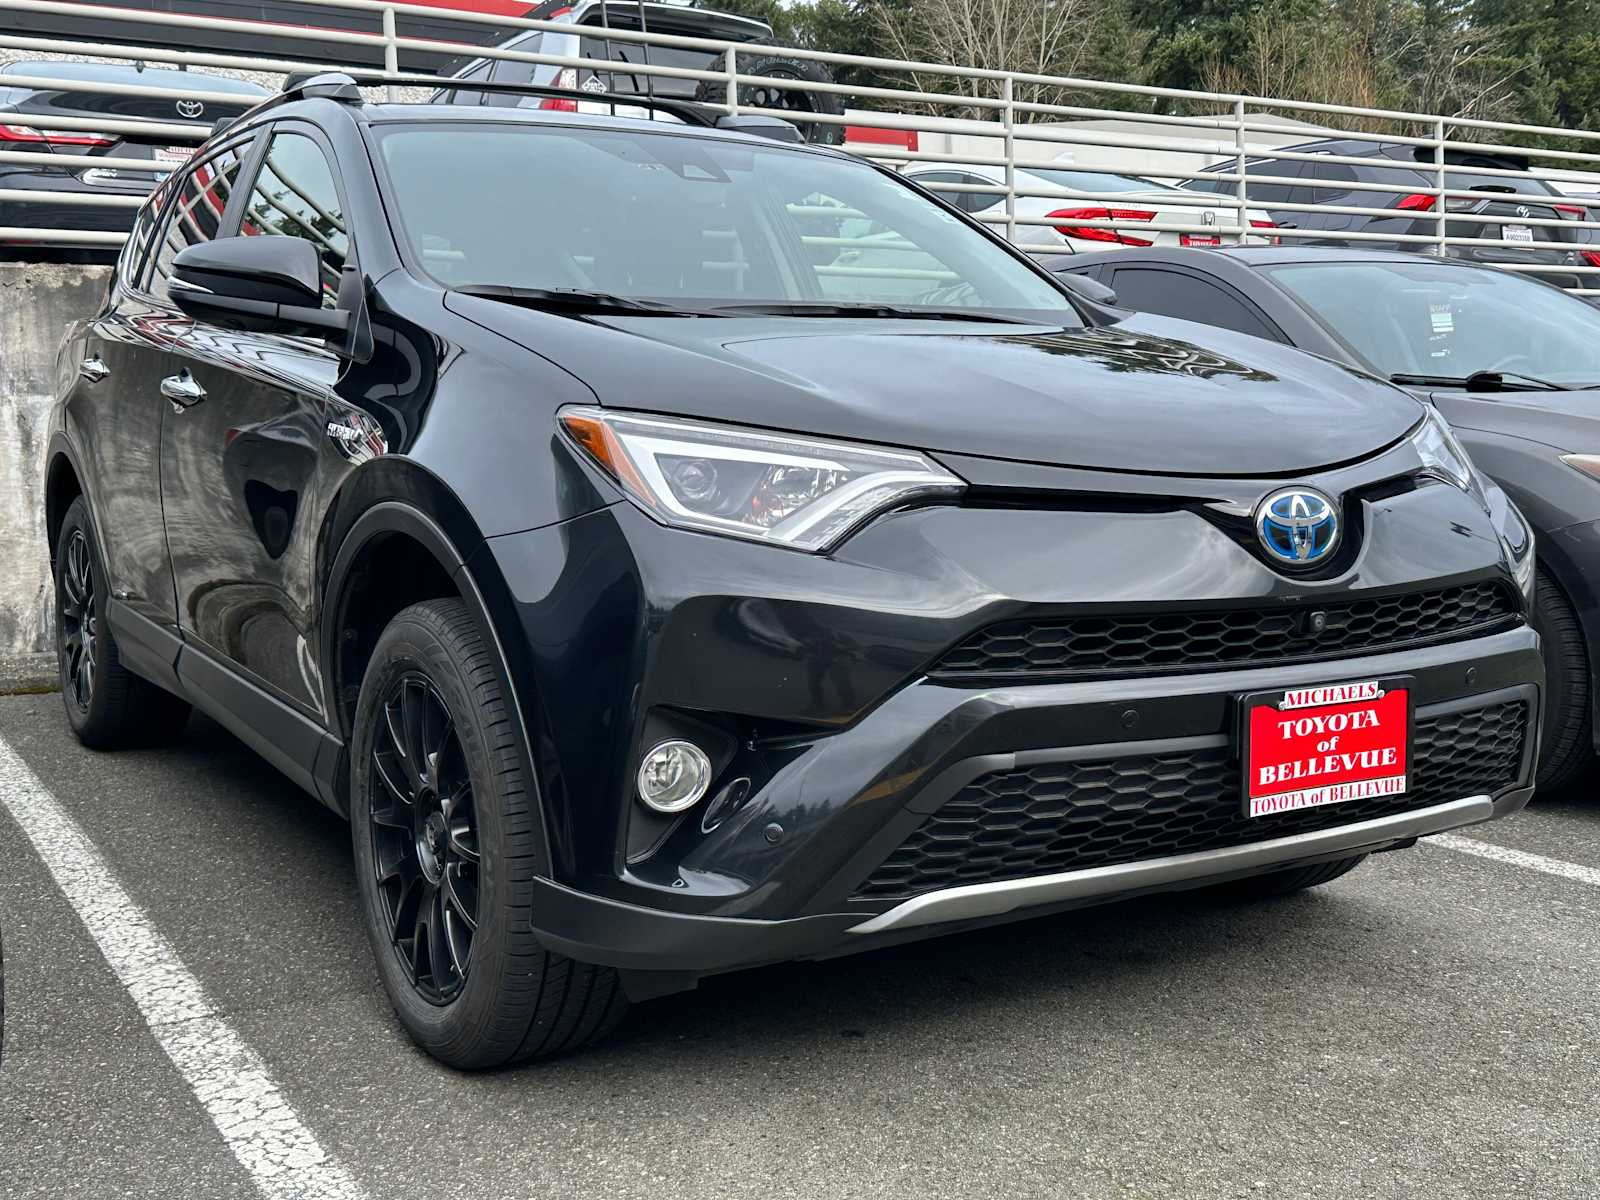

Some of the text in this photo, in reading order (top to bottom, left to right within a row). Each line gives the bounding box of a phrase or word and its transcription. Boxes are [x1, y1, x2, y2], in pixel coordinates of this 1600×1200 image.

[1286, 683, 1377, 706] MICHAELS
[1277, 710, 1380, 739] TOYOTA
[1316, 736, 1340, 752] of
[1258, 747, 1398, 785] BELLEVUE
[1252, 778, 1404, 815] TOYOTA of BELLEVUE
